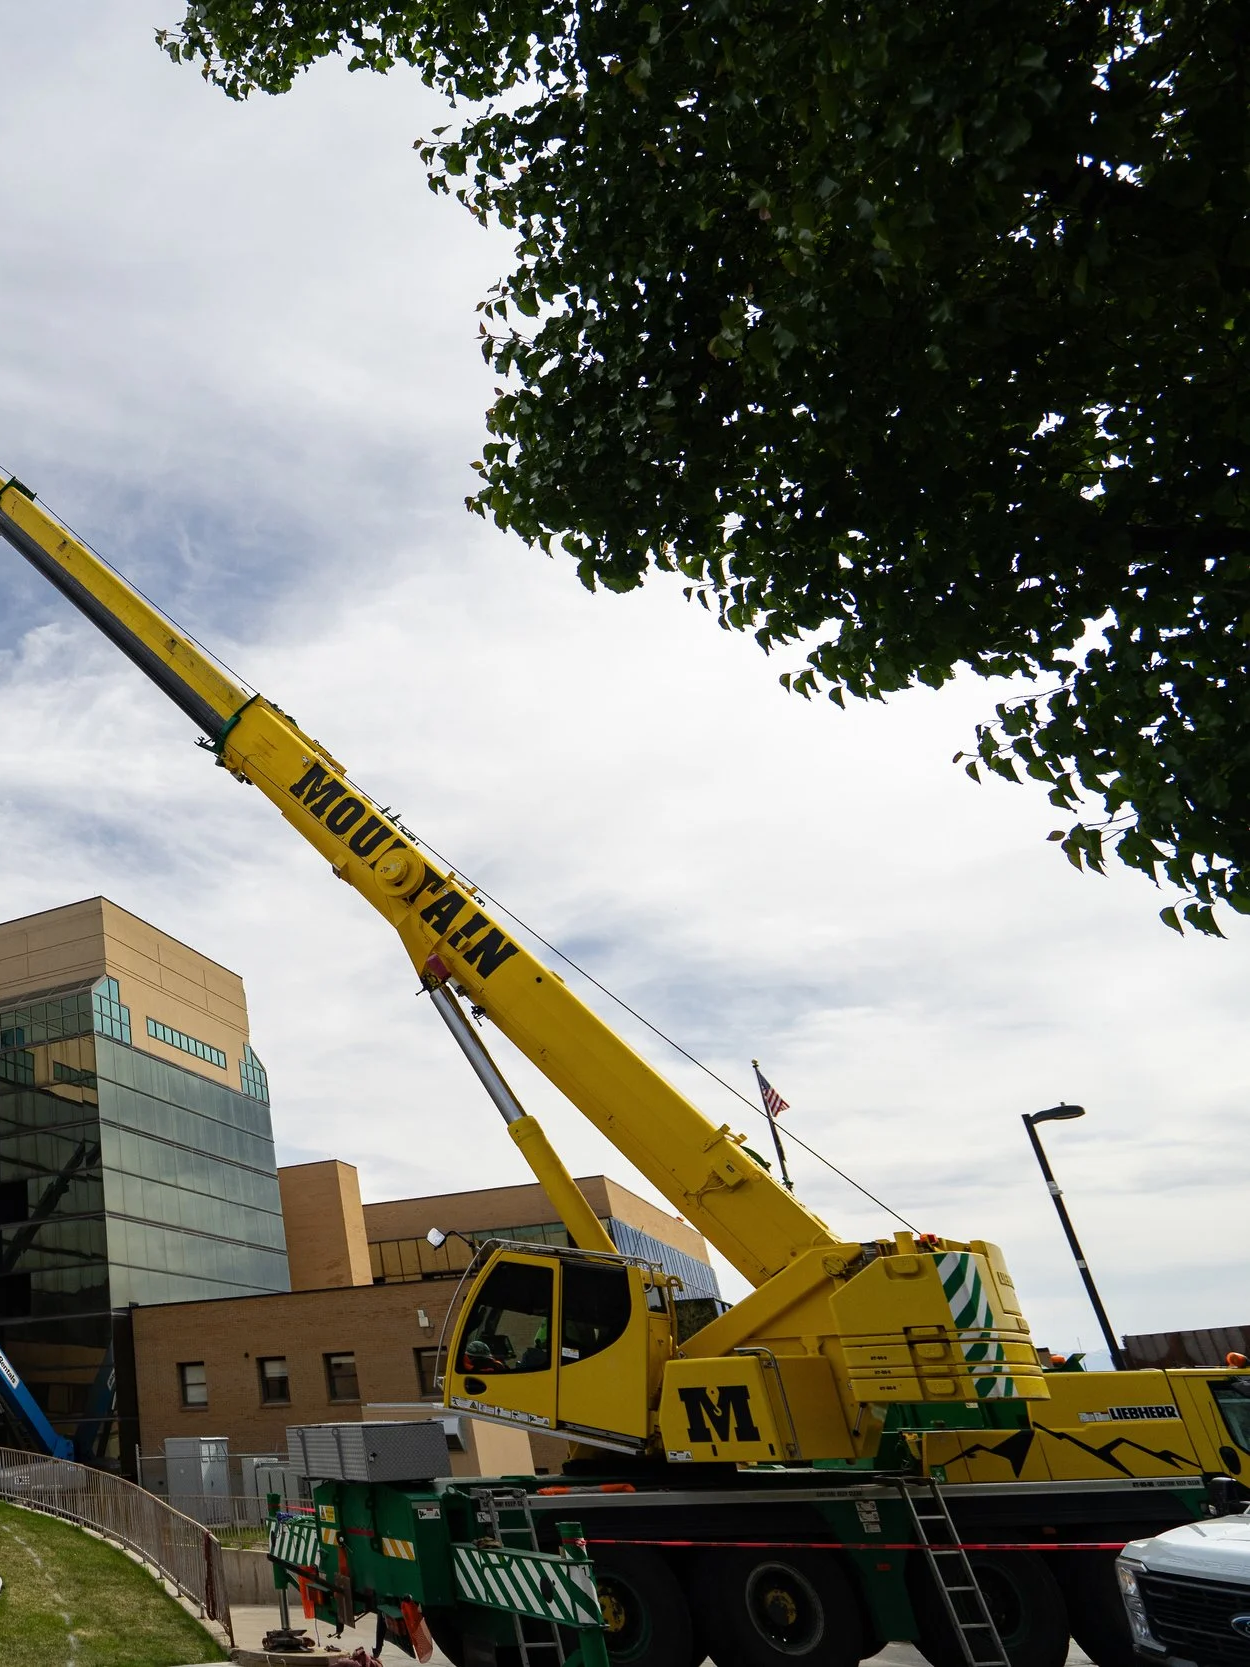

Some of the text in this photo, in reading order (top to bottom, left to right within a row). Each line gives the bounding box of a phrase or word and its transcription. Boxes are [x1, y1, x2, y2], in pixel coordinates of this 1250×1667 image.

[289, 762, 519, 980] MOUTAIN
[678, 1386, 761, 1442] M
[1109, 1406, 1178, 1420] LIEBHERR
